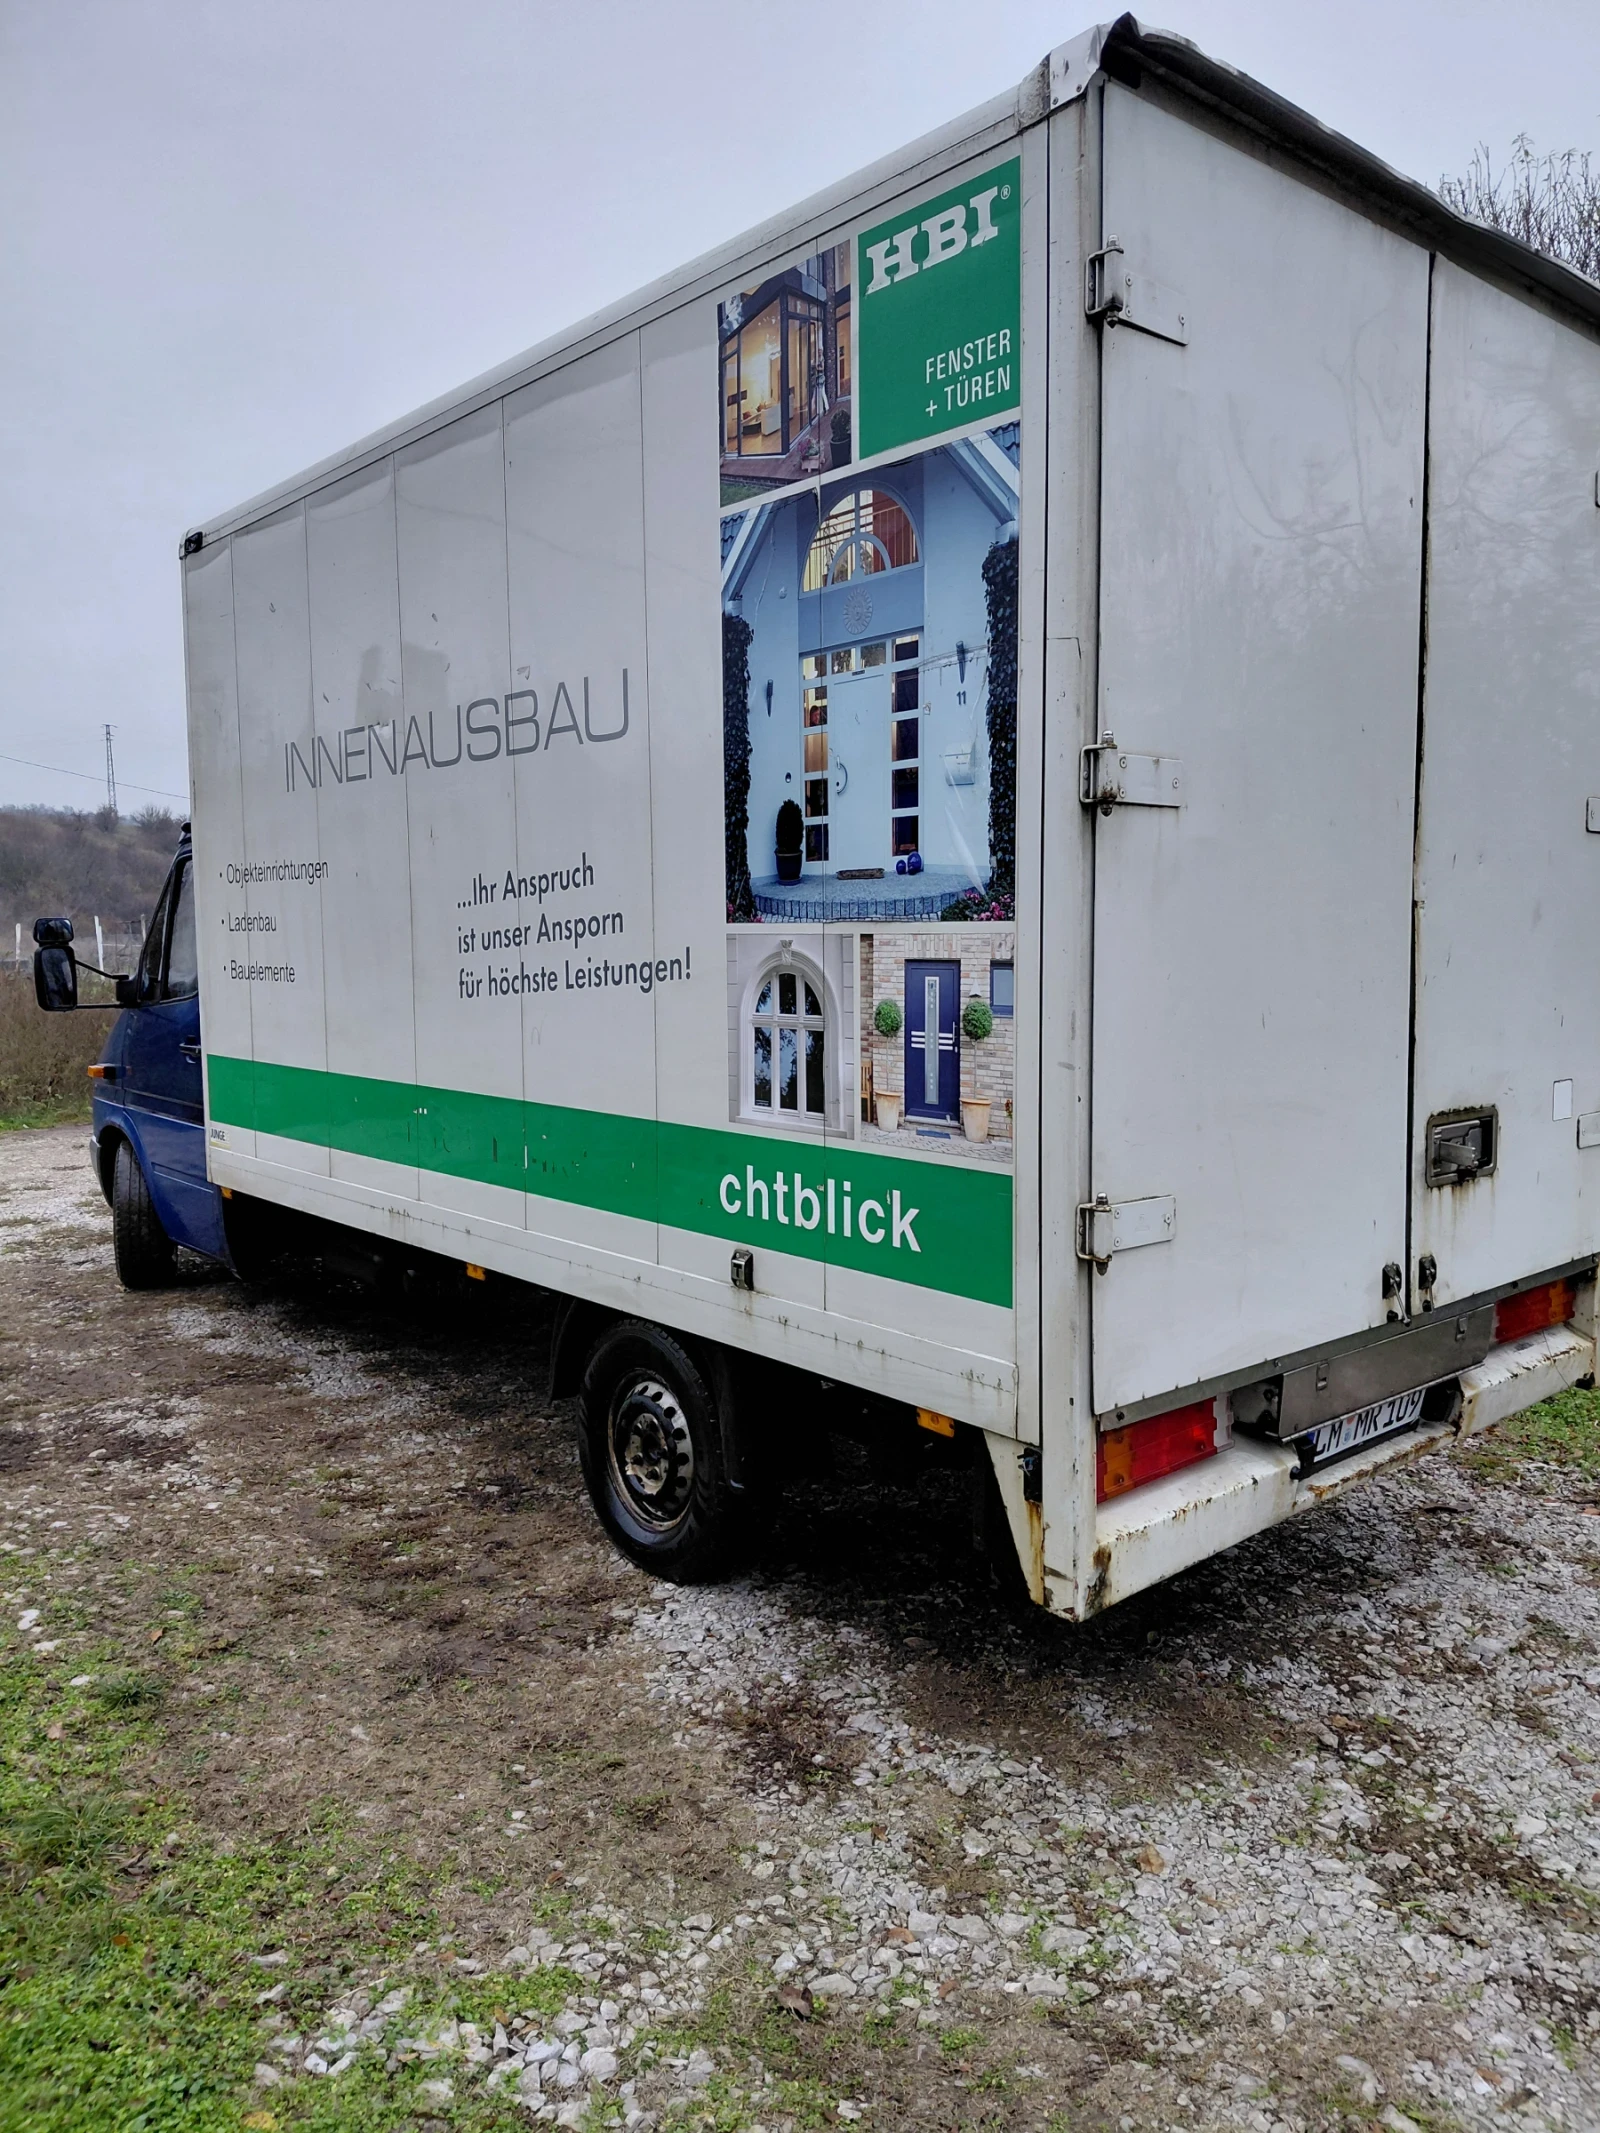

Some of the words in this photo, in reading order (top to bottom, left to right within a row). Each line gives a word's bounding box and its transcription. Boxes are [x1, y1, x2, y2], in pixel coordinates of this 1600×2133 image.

[925, 328, 1011, 384] FENSTER
[943, 364, 1011, 408] TÜREN
[284, 667, 629, 793] INNENAUSBAU
[226, 859, 329, 889] Objekteinrichtungen
[502, 851, 595, 905] Anspruch
[228, 911, 277, 932] Ladenbau
[457, 926, 477, 954] ist
[481, 925, 532, 951] unser
[536, 911, 624, 949] Ansporn
[230, 959, 296, 983] Bauelemente
[458, 967, 483, 999] für
[488, 961, 558, 996] höchste
[564, 946, 691, 993] Leistungen!
[719, 1164, 922, 1253] chtblick
[1314, 1423, 1343, 1456] LM
[1353, 1407, 1383, 1441] MR
